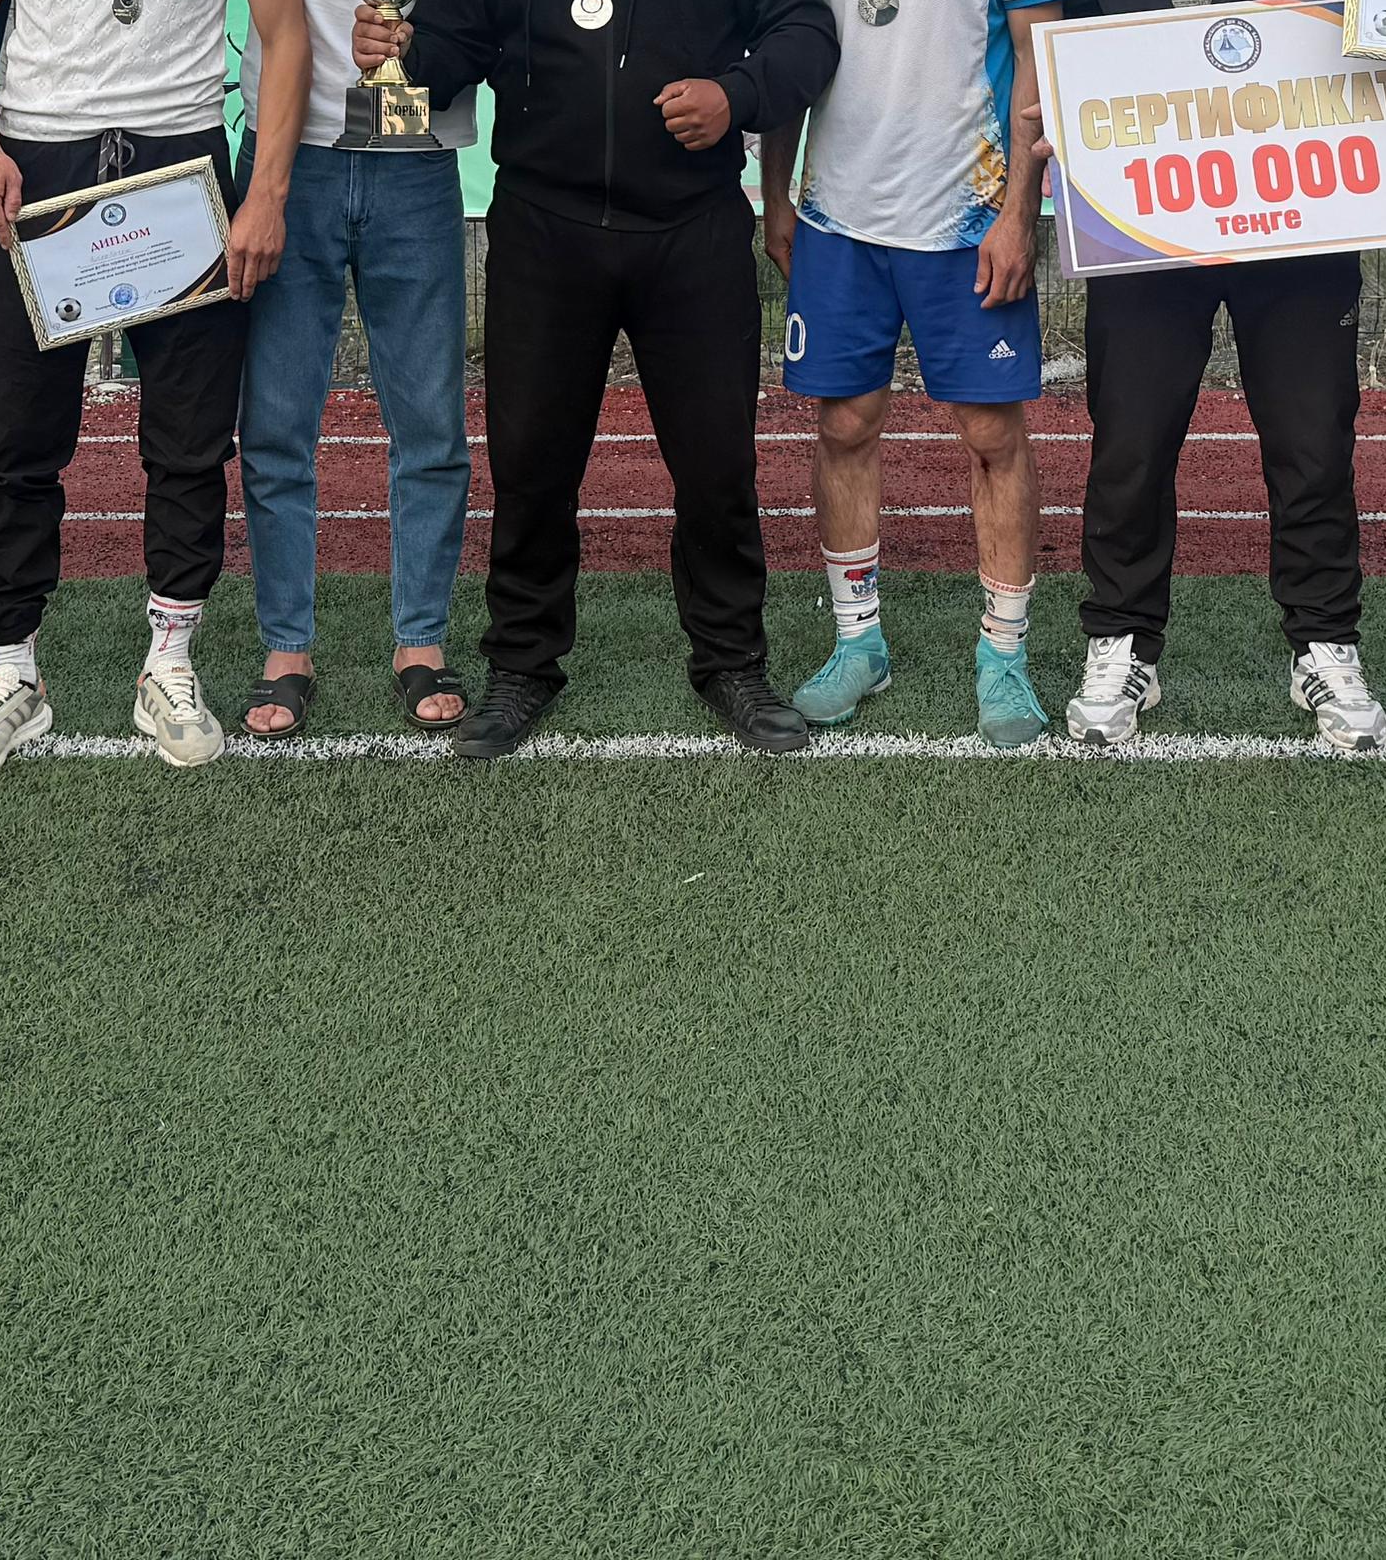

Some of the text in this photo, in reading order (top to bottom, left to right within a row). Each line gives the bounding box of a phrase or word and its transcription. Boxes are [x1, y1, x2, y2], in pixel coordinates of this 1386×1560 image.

[1124, 135, 1381, 216] 100 000
[1215, 207, 1303, 236] теңге
[91, 227, 151, 252] ДИПЛОМ
